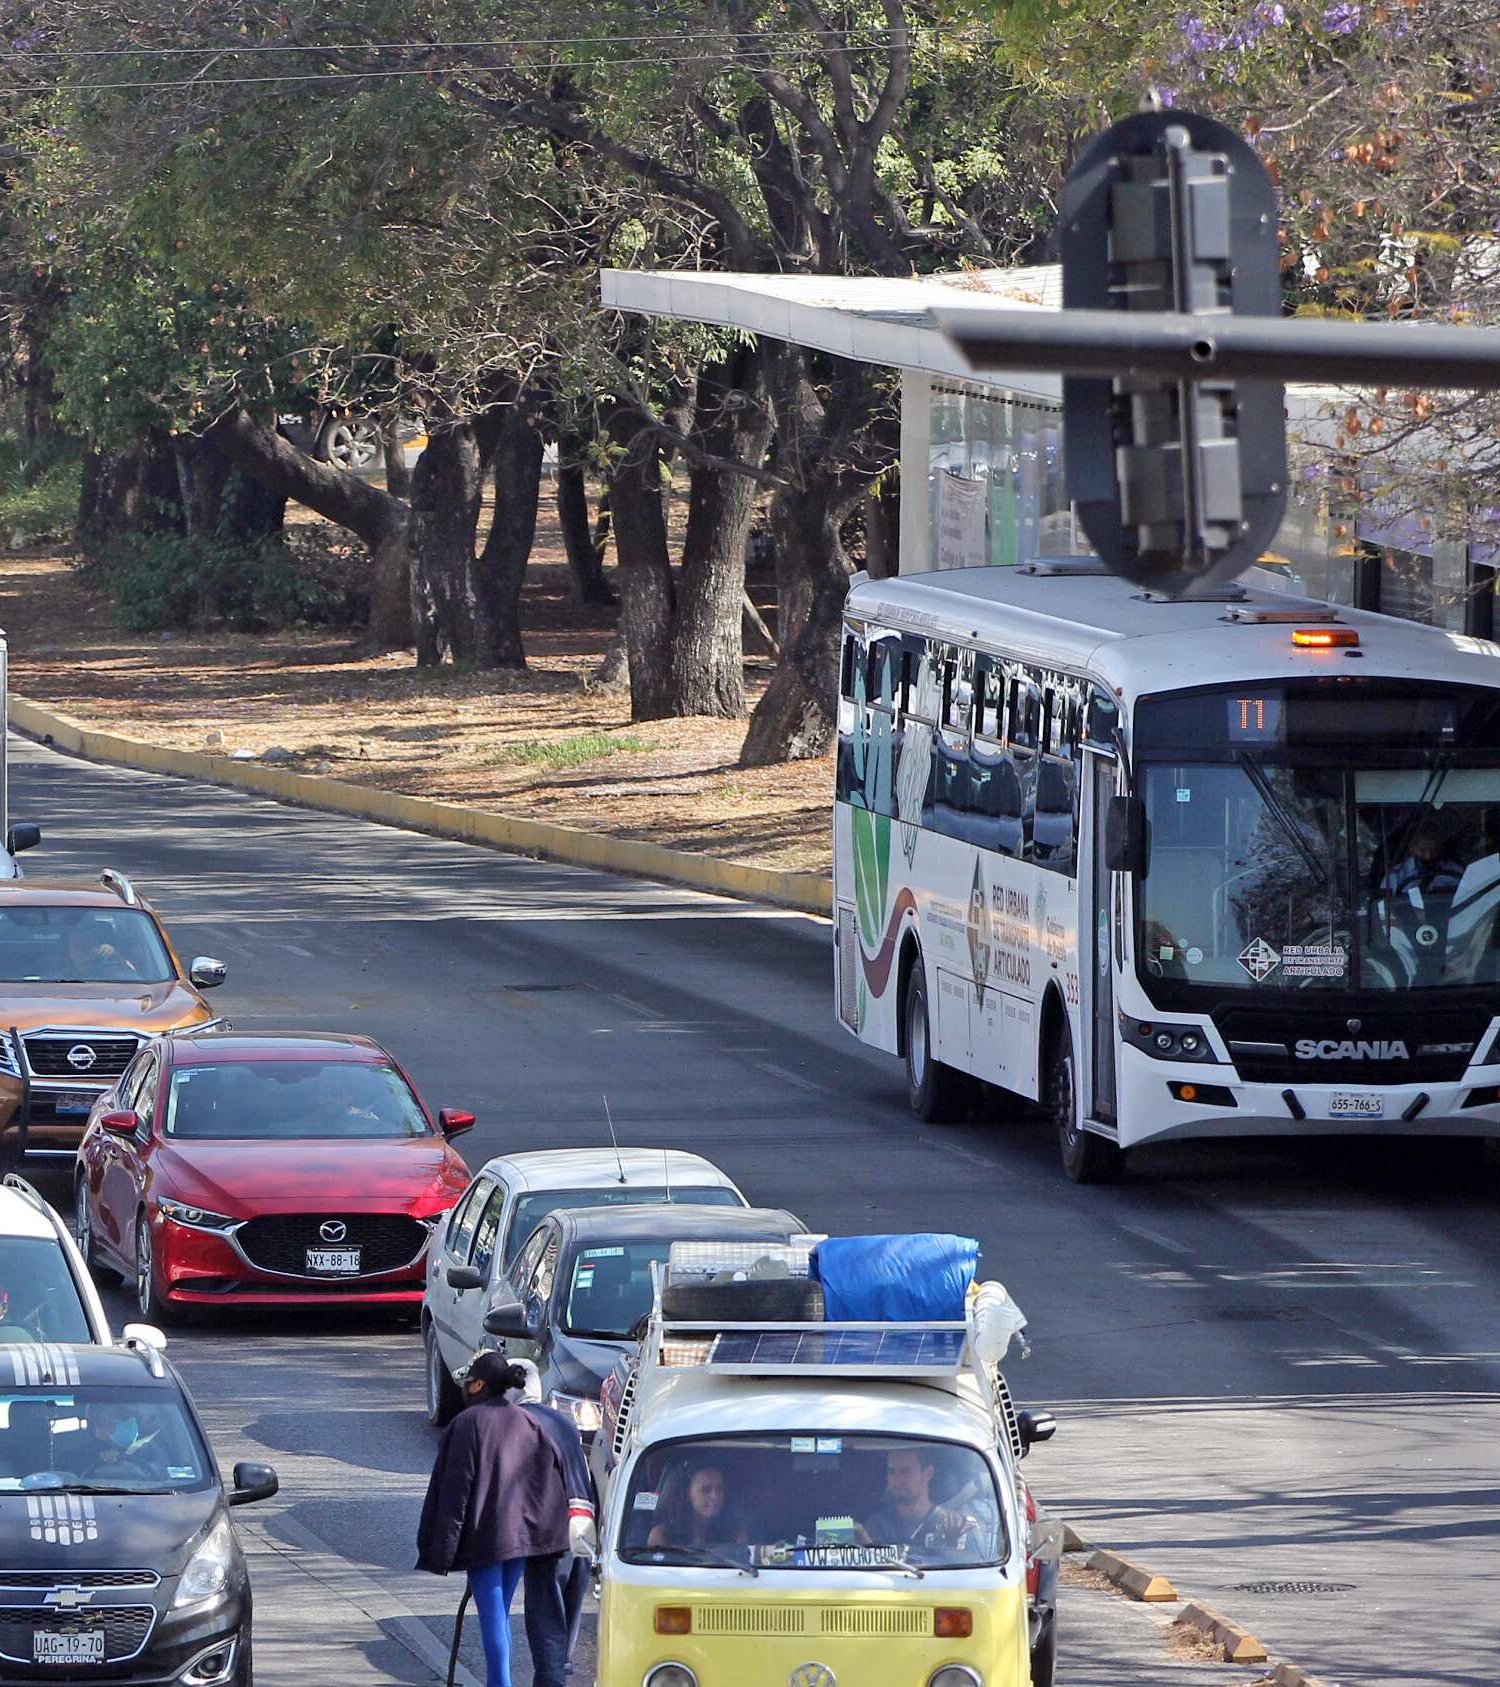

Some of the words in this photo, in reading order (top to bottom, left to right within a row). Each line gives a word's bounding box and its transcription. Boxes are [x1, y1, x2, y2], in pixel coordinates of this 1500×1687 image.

[1236, 699, 1263, 728] T1
[992, 884, 1005, 912] RED
[1005, 887, 1030, 921] URBANA
[1282, 945, 1303, 955] RED
[1304, 945, 1345, 956] URBANA
[994, 948, 1031, 986] ARTICULADO
[1282, 966, 1345, 976] ARTICULADO
[1295, 1039, 1410, 1060] SCANIA
[307, 1254, 360, 1266] NXX-88-18
[35, 1636, 103, 1654] UAG-19-70
[37, 1655, 98, 1665] PEREGRINA
